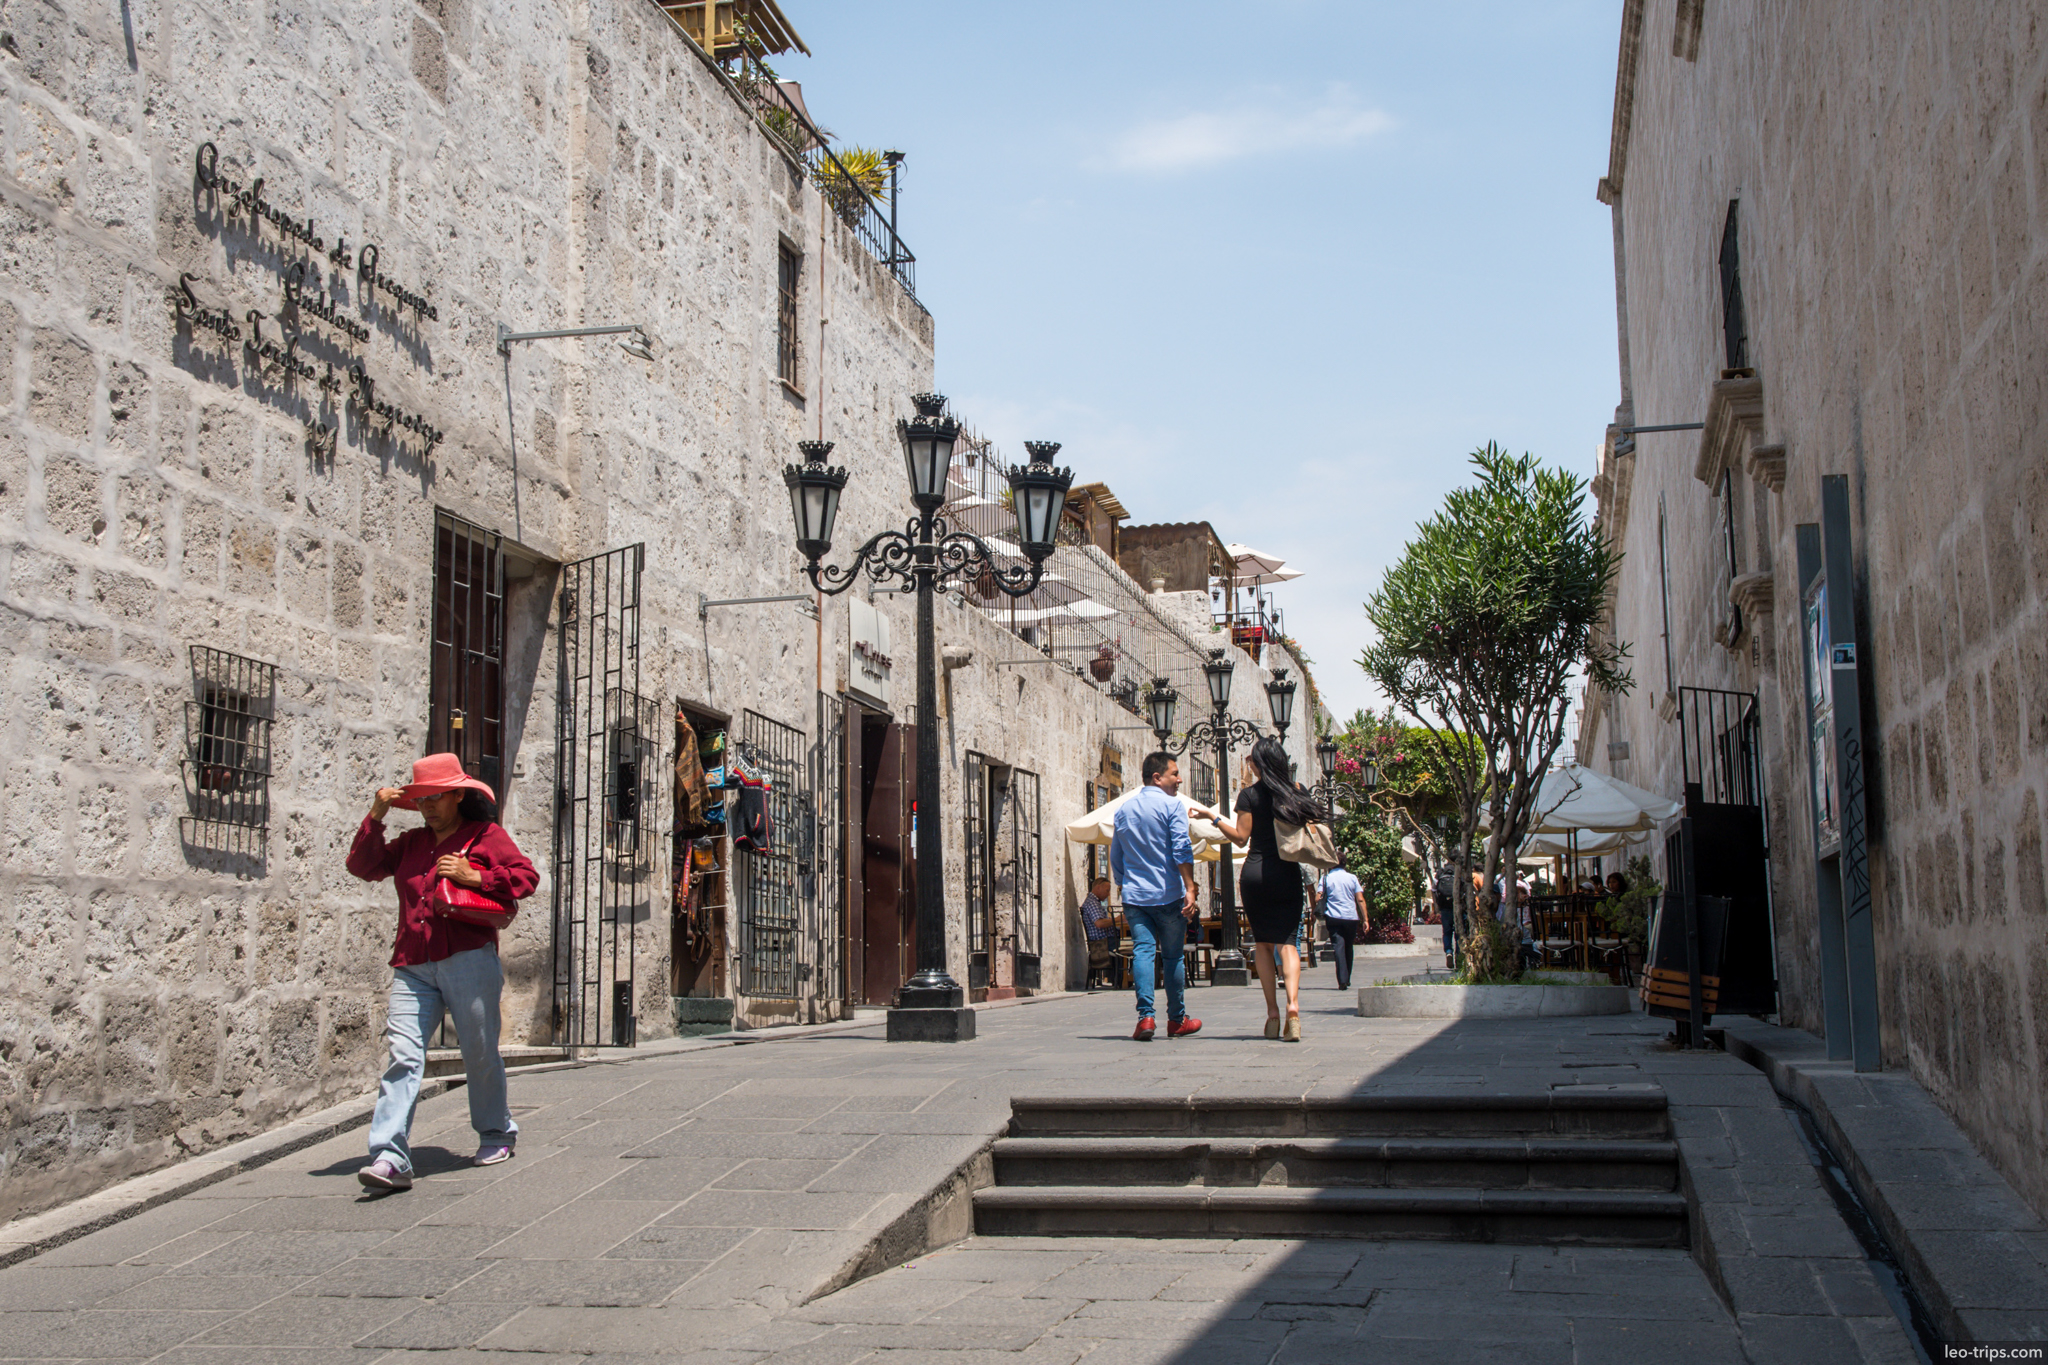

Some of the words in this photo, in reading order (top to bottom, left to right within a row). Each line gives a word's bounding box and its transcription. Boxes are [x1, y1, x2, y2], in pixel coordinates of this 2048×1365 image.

[196, 142, 325, 253] Arzobispado
[329, 238, 354, 270] de
[359, 243, 440, 323] Arequipa
[285, 261, 371, 343] Auditorio
[176, 272, 242, 342] Santo
[244, 309, 316, 380] Toribio
[319, 362, 344, 395] de
[348, 364, 444, 456] Mogrovejo
